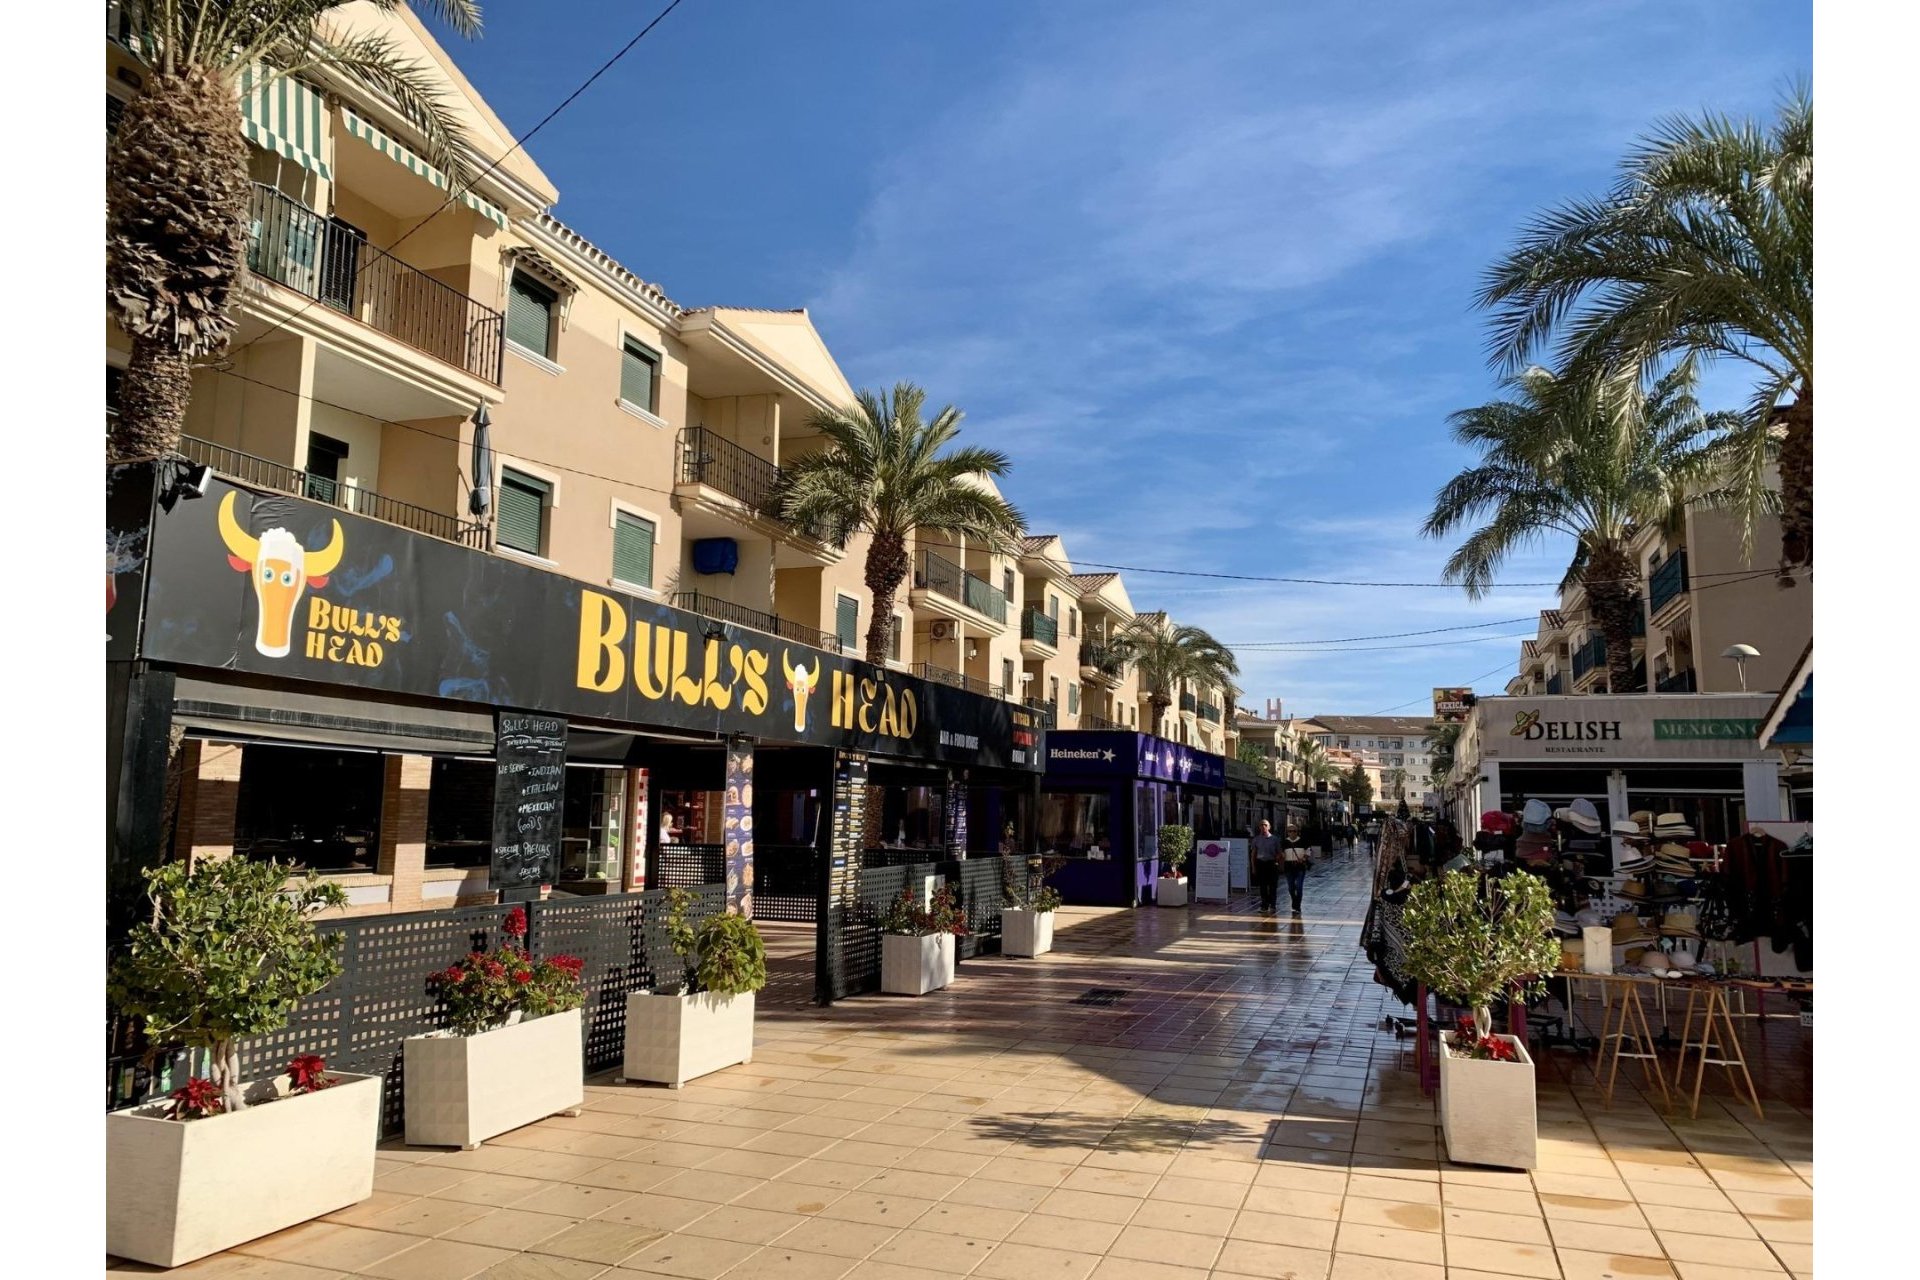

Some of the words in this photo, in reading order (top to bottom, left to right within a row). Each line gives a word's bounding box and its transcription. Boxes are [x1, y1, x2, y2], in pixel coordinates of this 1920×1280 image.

[309, 596, 402, 643] BULL'S
[306, 631, 384, 668] HEAD
[577, 590, 768, 715] BULL'S
[831, 670, 917, 739] HEAD
[533, 720, 558, 732] HEAD
[1524, 720, 1622, 741] DELISH
[1660, 723, 1746, 736] MEXICAN
[1050, 748, 1099, 760] Heineken
[1545, 746, 1606, 754] RESTAURANTE
